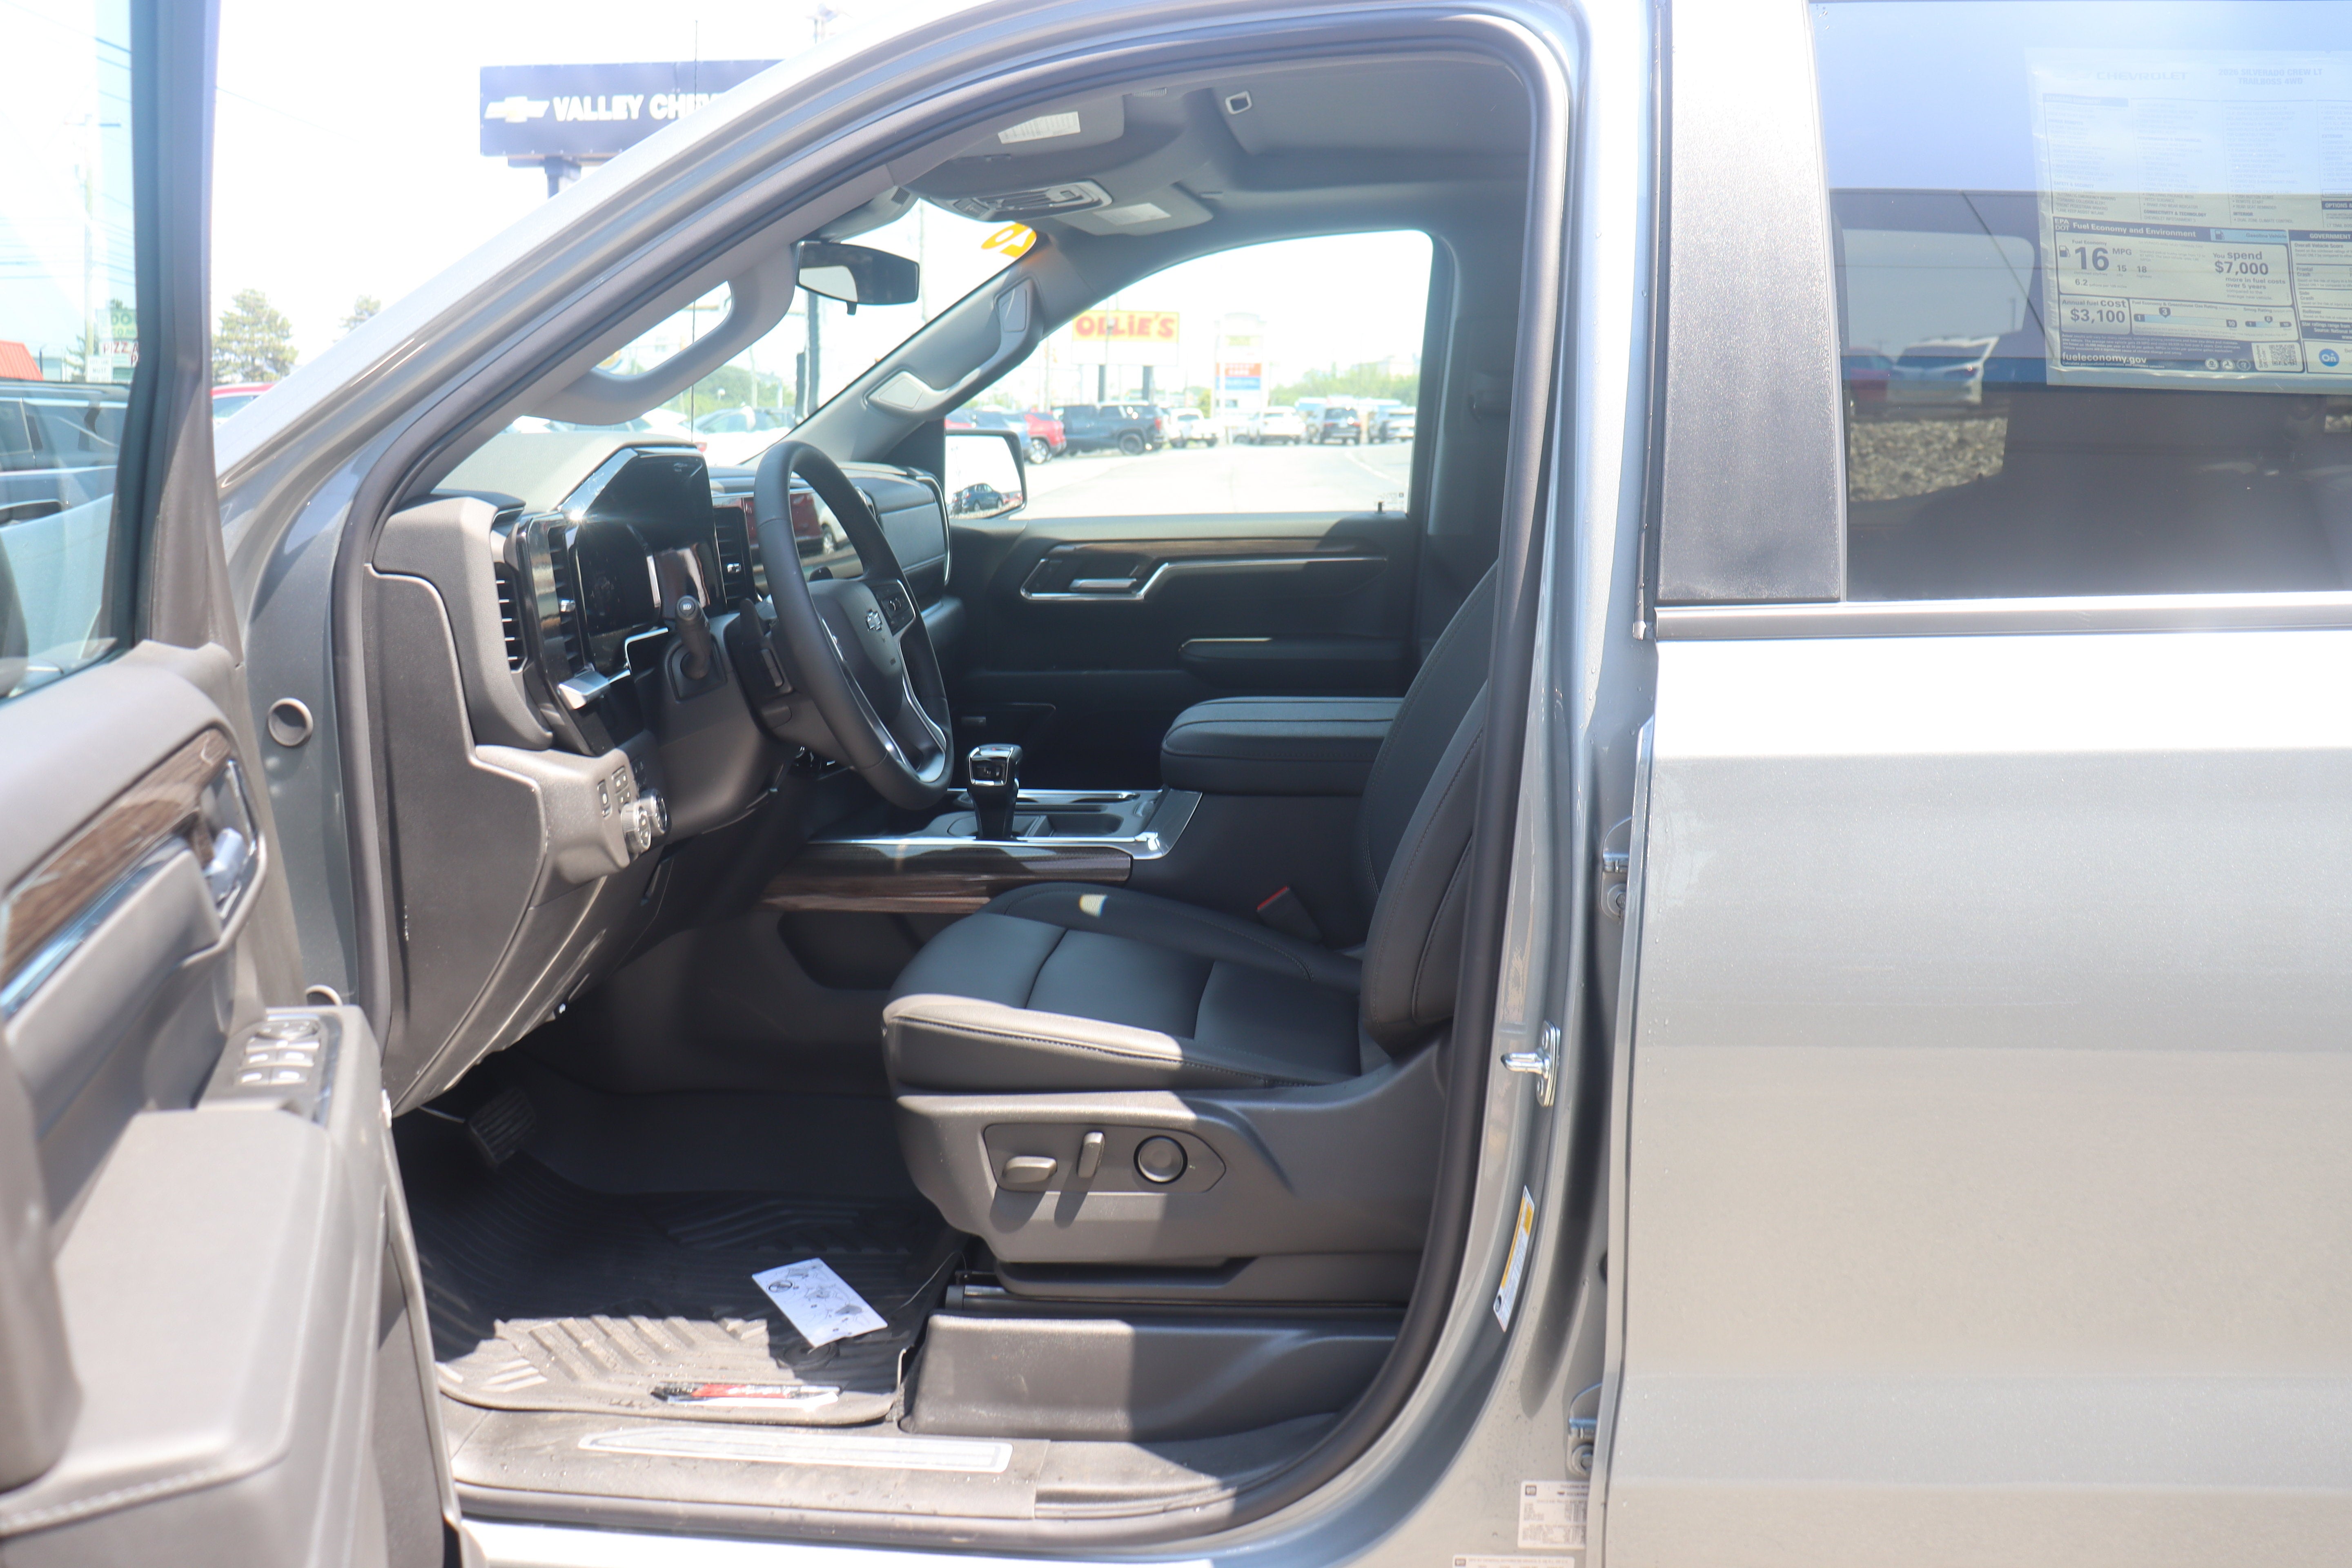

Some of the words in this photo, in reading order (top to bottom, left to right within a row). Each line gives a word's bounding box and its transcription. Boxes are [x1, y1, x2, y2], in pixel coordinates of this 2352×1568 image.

[2097, 71, 2188, 81] CHEVROLET
[553, 94, 644, 121] VALLEY
[2091, 224, 2127, 234] Economy
[2146, 229, 2196, 238] Environment
[2075, 246, 2109, 271] 16
[2112, 247, 2132, 256] MPG
[2227, 252, 2263, 261] spend
[2215, 261, 2269, 275] $7,000
[2100, 299, 2126, 308] cost
[2070, 307, 2125, 324] $3,100
[2062, 352, 2147, 364] fueleconomy.gov
